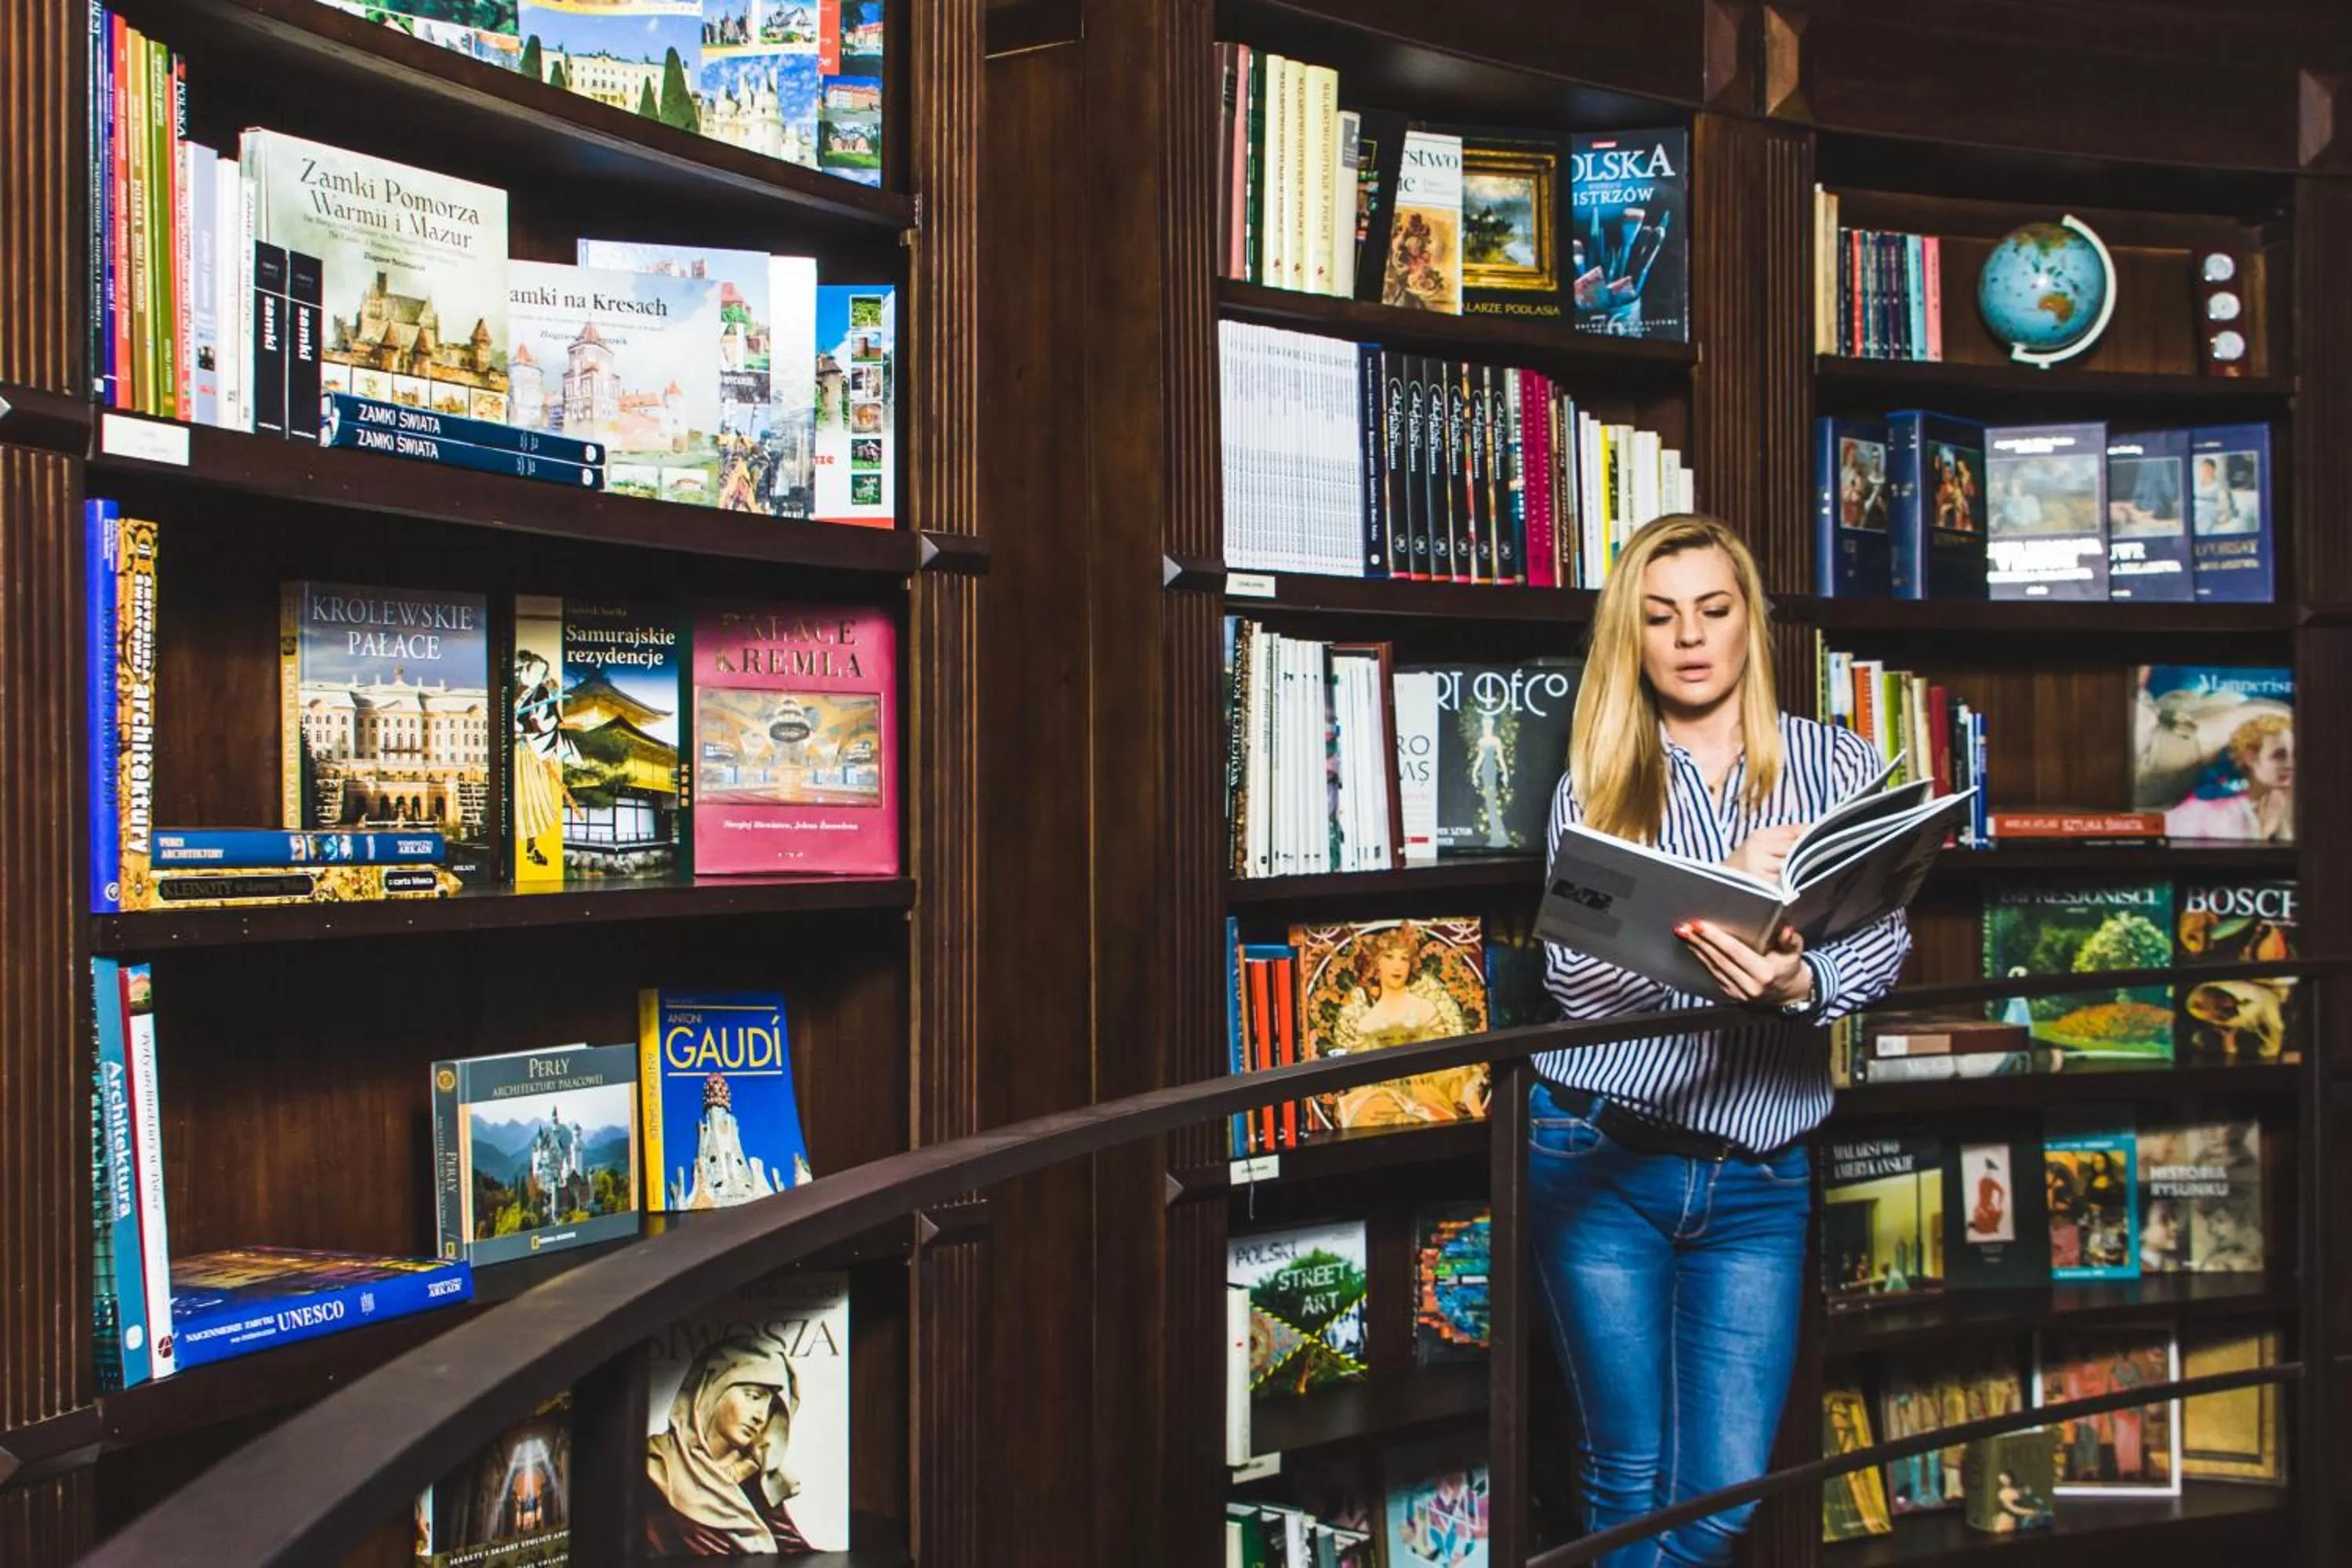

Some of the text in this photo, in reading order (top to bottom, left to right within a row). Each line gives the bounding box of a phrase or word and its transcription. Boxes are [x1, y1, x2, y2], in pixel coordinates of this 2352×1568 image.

[177, 81, 187, 137] POLSKA
[1571, 143, 1676, 183] OLSKA
[300, 158, 480, 225] Zamki Pomorza
[1573, 185, 1655, 206] ISTRZÓW
[311, 189, 387, 230] Warmii
[394, 212, 402, 233] i
[408, 212, 474, 249] Mazur
[509, 286, 668, 317] amki na Kresach
[1504, 304, 1561, 316] PODLASIA
[263, 295, 278, 353] zamki
[297, 306, 313, 362] zamki
[358, 403, 441, 435] ZAMKI ŚWIATA
[356, 429, 440, 459] ZAMKI ŚWIATA
[314, 591, 474, 630] KRÓLEWSKIE
[347, 630, 442, 660] PAŁACE
[565, 624, 677, 649] Samurajskie
[566, 647, 664, 670] rezydencje
[714, 647, 866, 678] KREMLA
[1473, 668, 1569, 717] DÉCO
[1229, 638, 1243, 786] WOJCIECH KOSSAK
[129, 684, 153, 853] architektury
[667, 1010, 703, 1024] ANTONI
[666, 1014, 782, 1069] GAUDÍ
[528, 1056, 572, 1079] PERŁY
[492, 1073, 604, 1098] ARCHITEKTURY PAŁACOWEJ
[107, 1060, 133, 1217] Architektura
[445, 1151, 460, 1193] PERŁY
[2150, 1165, 2228, 1180] HISTORIA
[2150, 1181, 2230, 1197] RYSUNKU
[1234, 1239, 1298, 1268] POLSKI
[1277, 1261, 1349, 1292] STREET
[276, 1299, 345, 1333] UNESCO
[1301, 1290, 1340, 1317] ART
